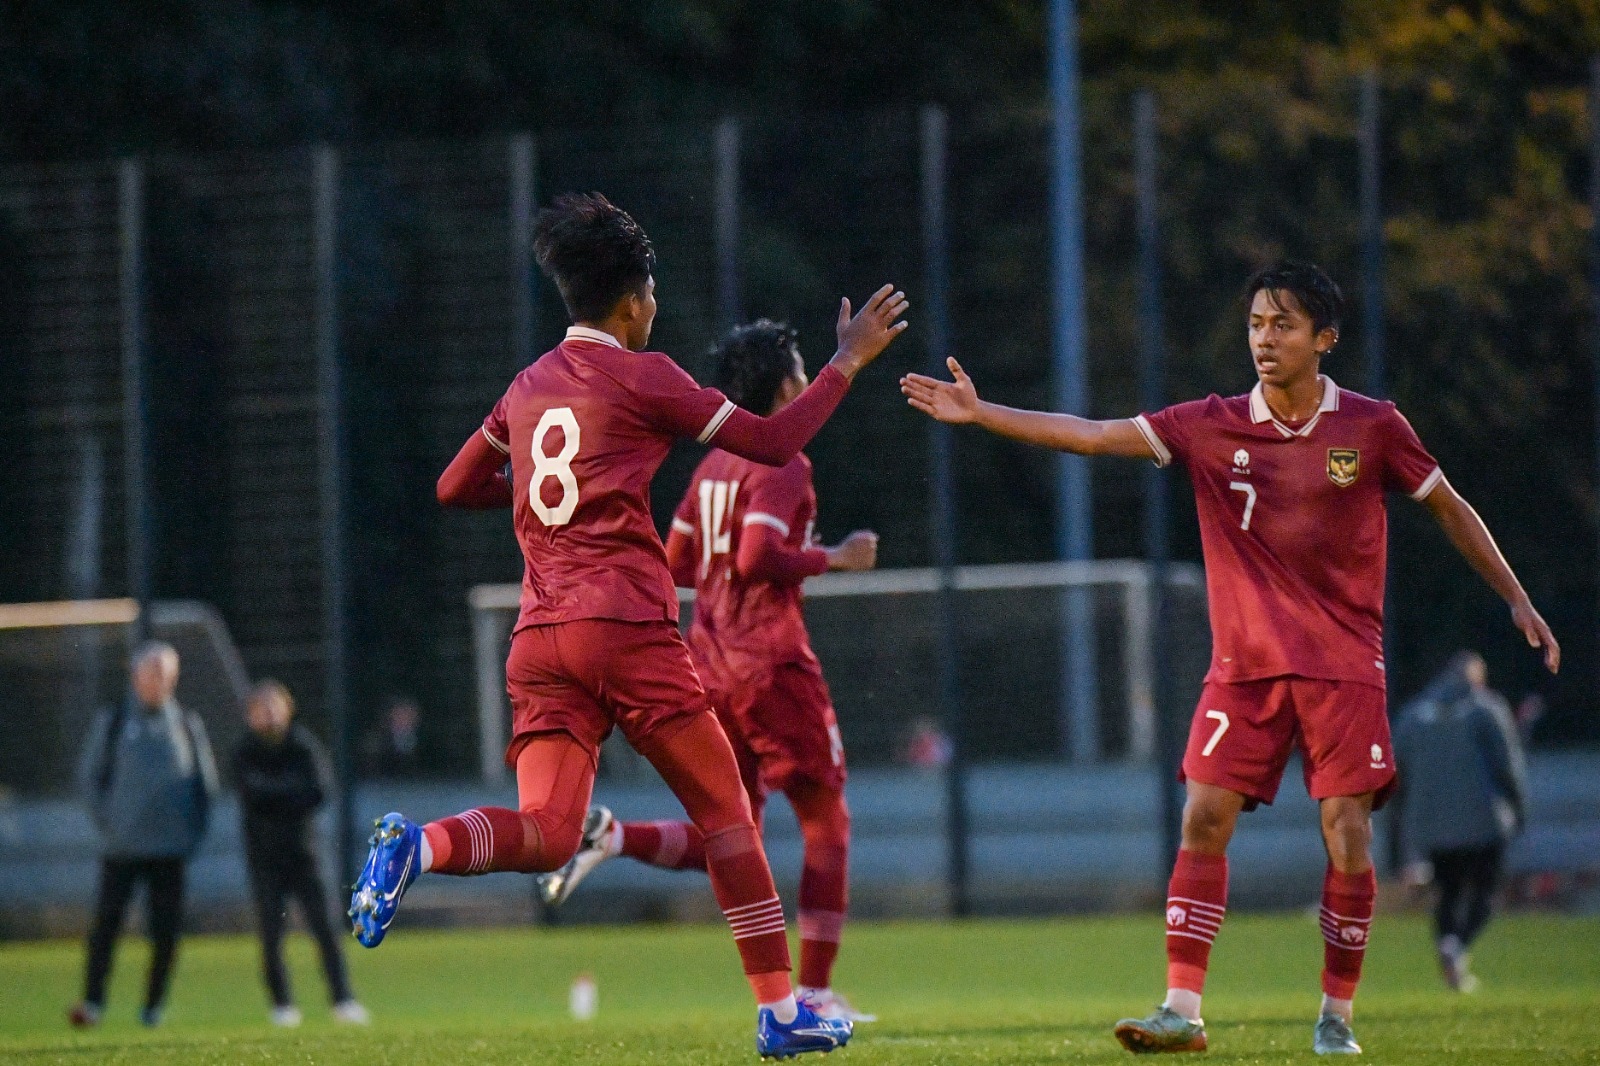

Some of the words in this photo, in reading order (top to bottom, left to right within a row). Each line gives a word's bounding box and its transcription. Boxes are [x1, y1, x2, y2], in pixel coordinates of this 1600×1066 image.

[529, 407, 580, 526] 8
[699, 479, 740, 580] 14
[1229, 482, 1256, 530] 7
[1202, 710, 1230, 756] 7
